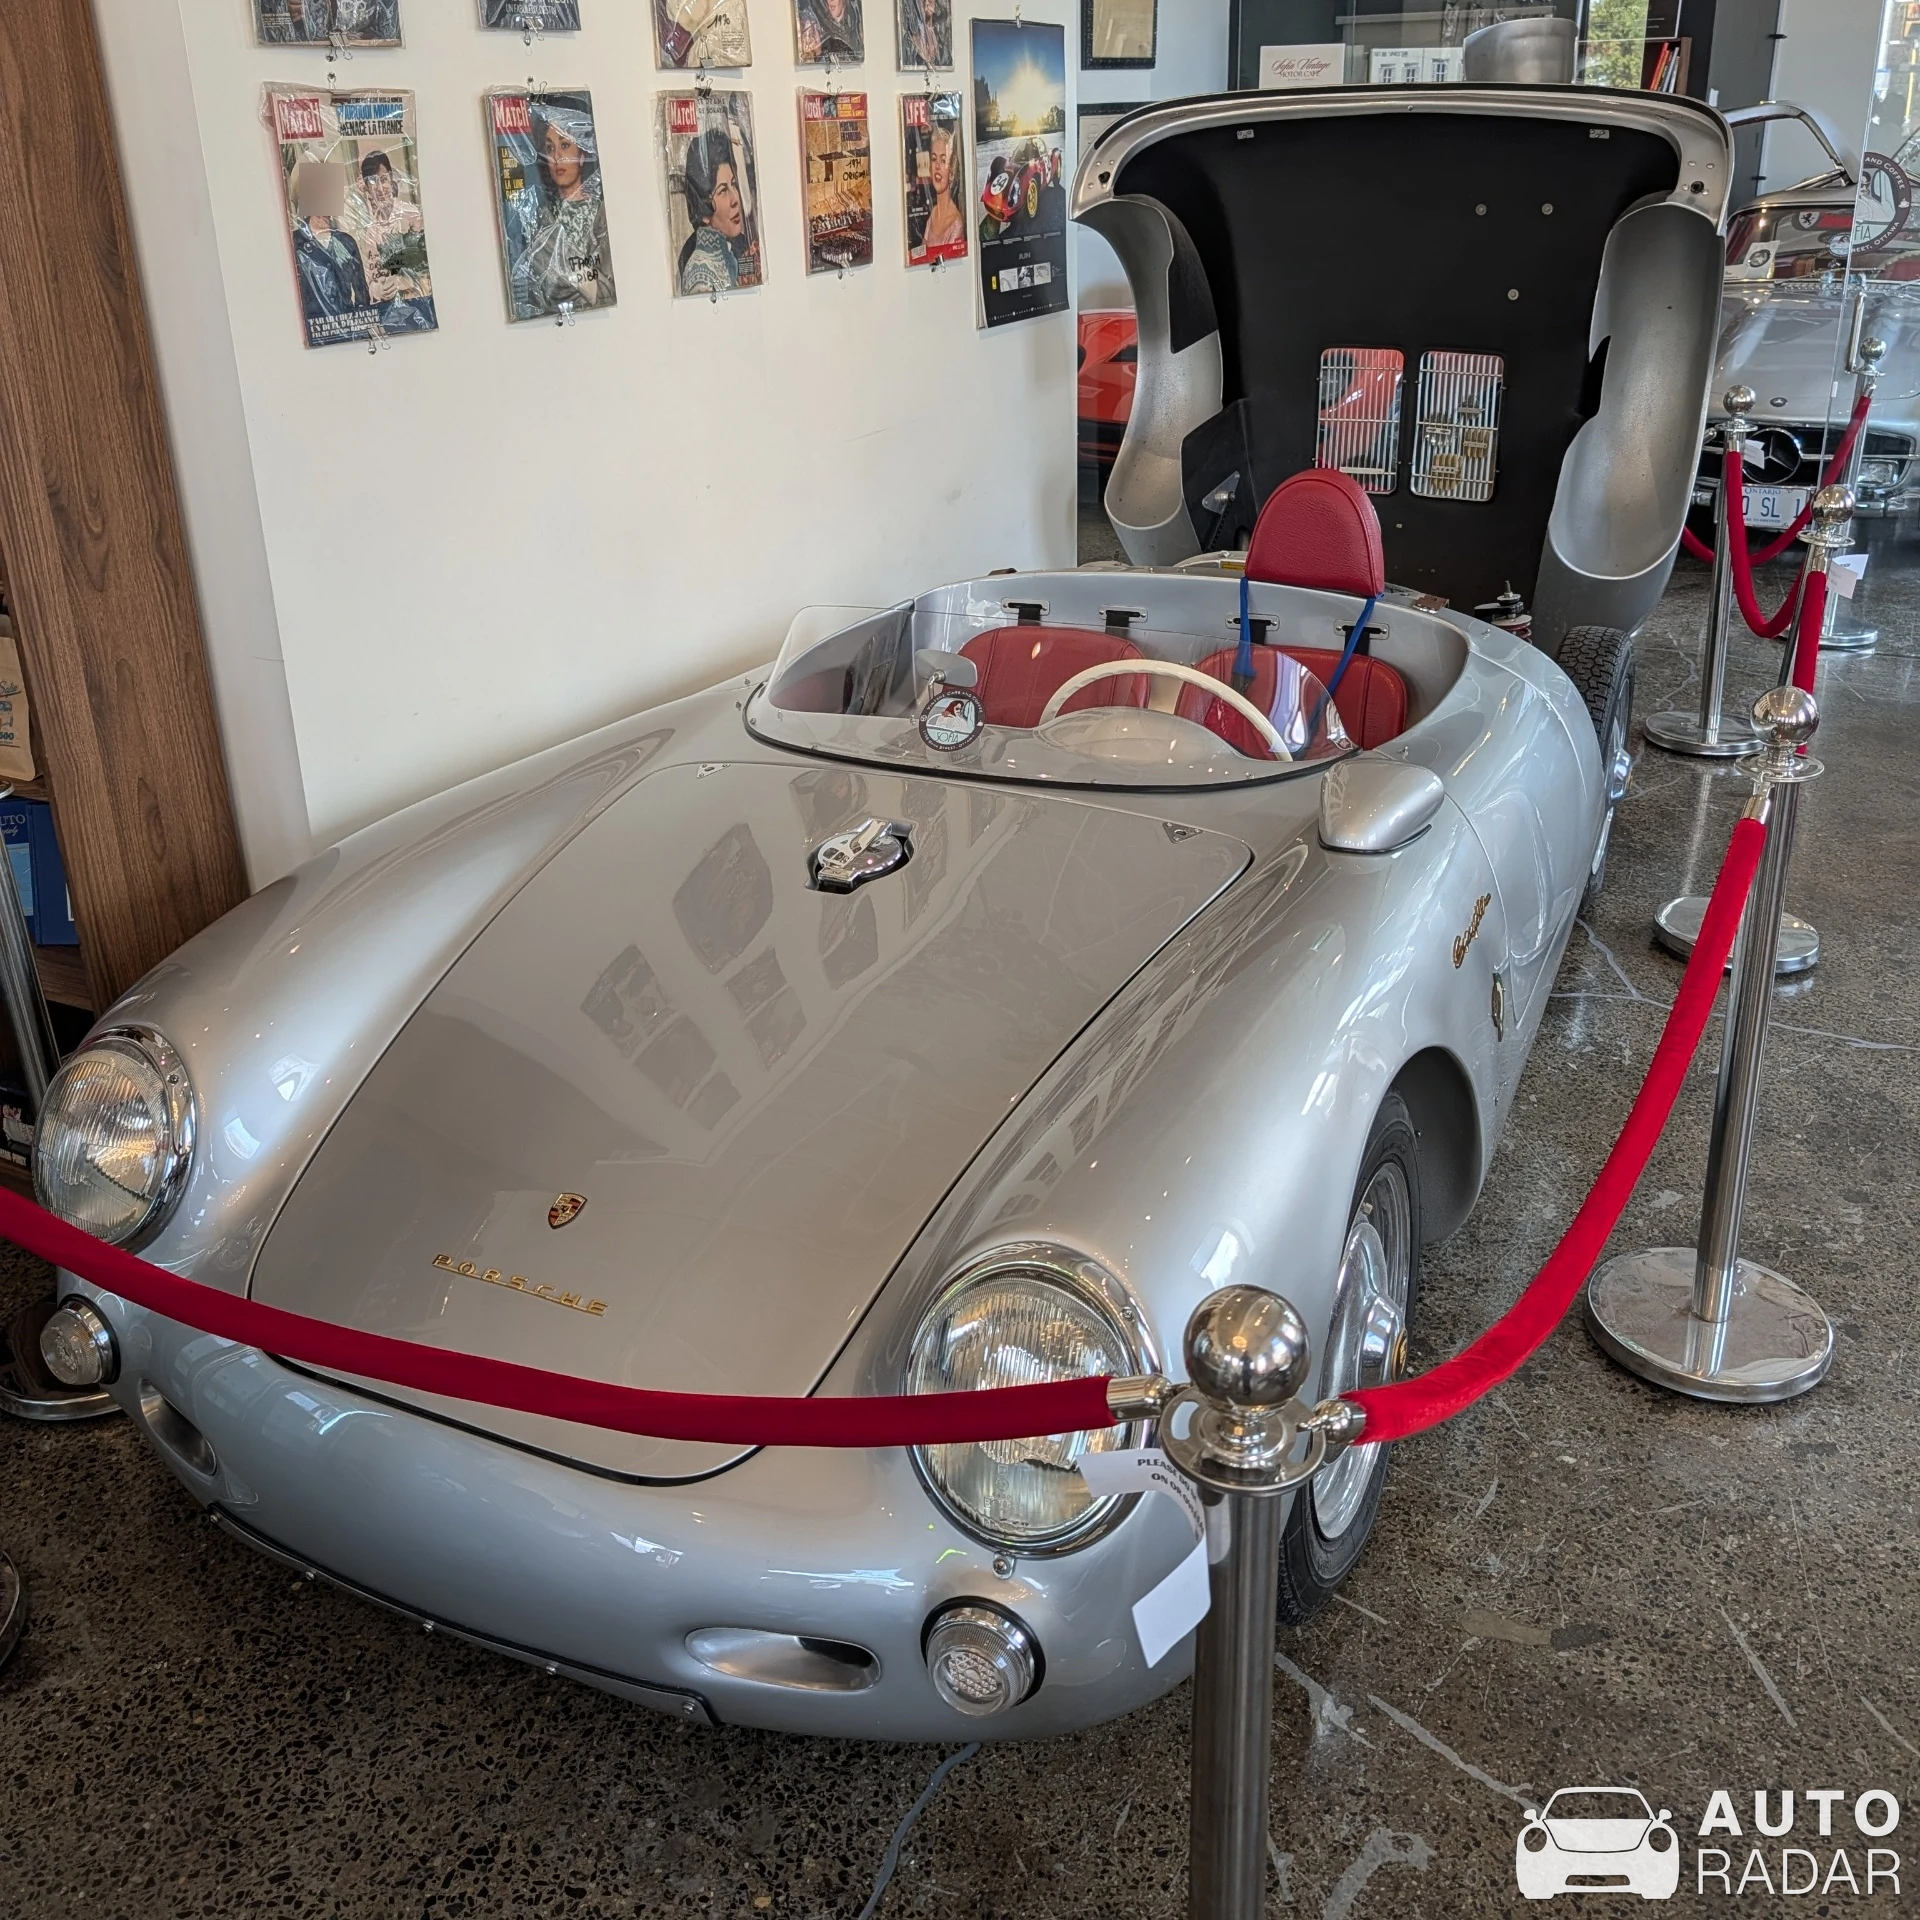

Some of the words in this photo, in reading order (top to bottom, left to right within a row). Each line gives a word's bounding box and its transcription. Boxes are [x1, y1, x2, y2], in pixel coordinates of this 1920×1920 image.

[1297, 57, 1331, 75] Vintage
[278, 102, 322, 134] MATCH
[494, 99, 530, 128] MATCH
[670, 101, 697, 126] MATCH
[905, 101, 926, 124] LIFE
[378, 119, 404, 135] FRANCE
[1864, 156, 1883, 166] AND
[1883, 162, 1906, 190] COFFEE
[1873, 221, 1901, 246] OTTAWA
[1744, 487, 1782, 495] ONTARIO
[1760, 496, 1781, 519] SL
[936, 731, 959, 743] SOFIA
[432, 1253, 609, 1318] PORSCHE
[1137, 1458, 1178, 1477] PLEASE
[1151, 1472, 1169, 1485] ON
